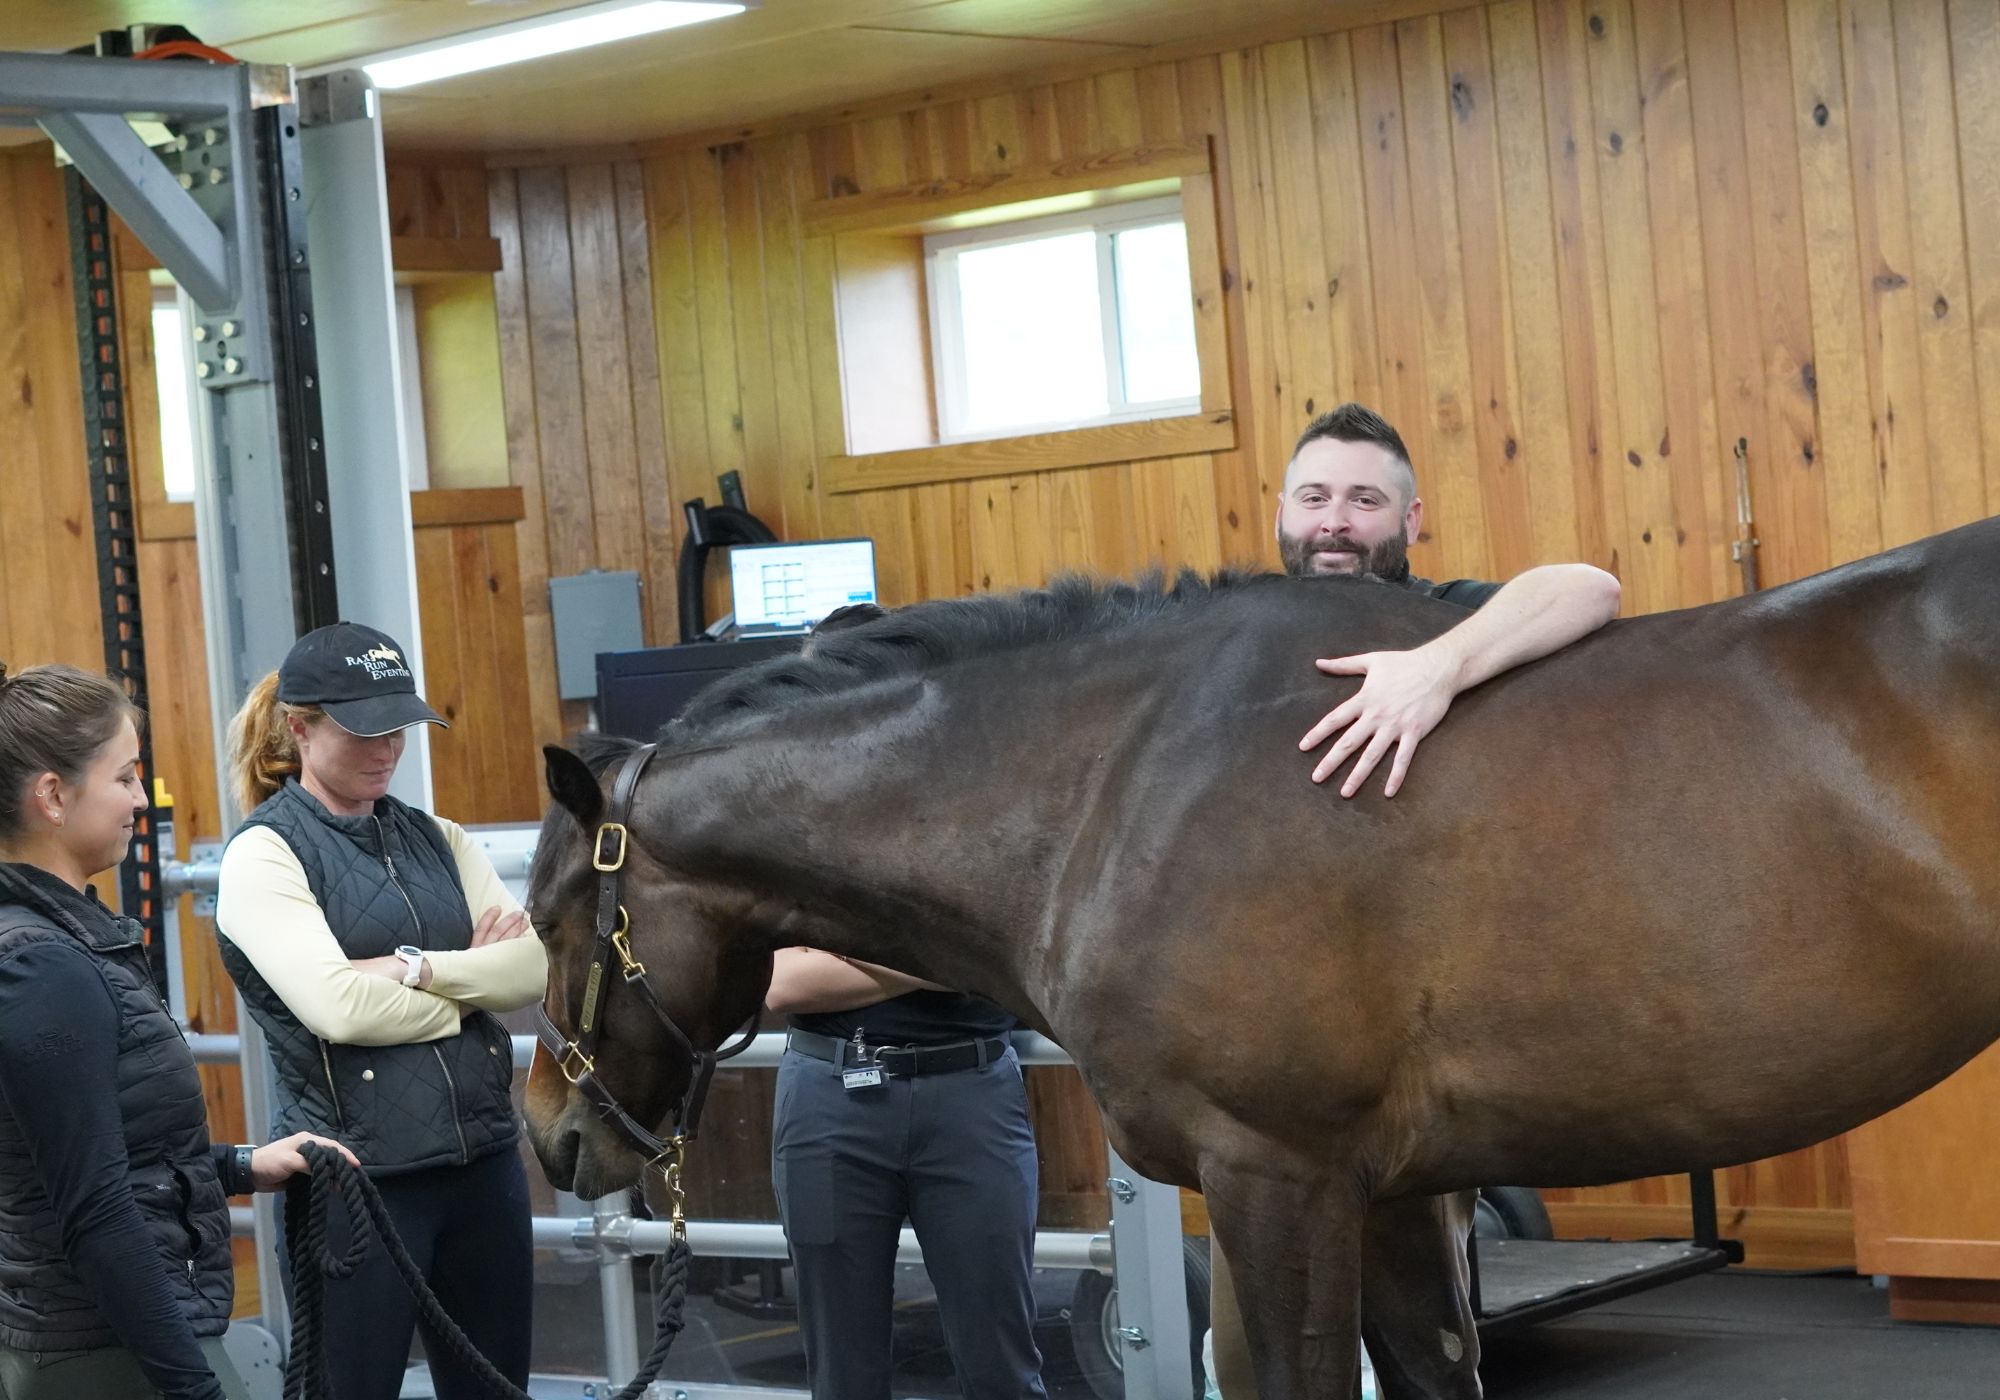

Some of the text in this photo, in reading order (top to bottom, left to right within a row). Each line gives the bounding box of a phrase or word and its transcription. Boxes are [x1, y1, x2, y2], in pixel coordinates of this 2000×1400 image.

[345, 653, 370, 666] RAX
[363, 660, 388, 672] RUN
[371, 668, 410, 680] EVENTIN
